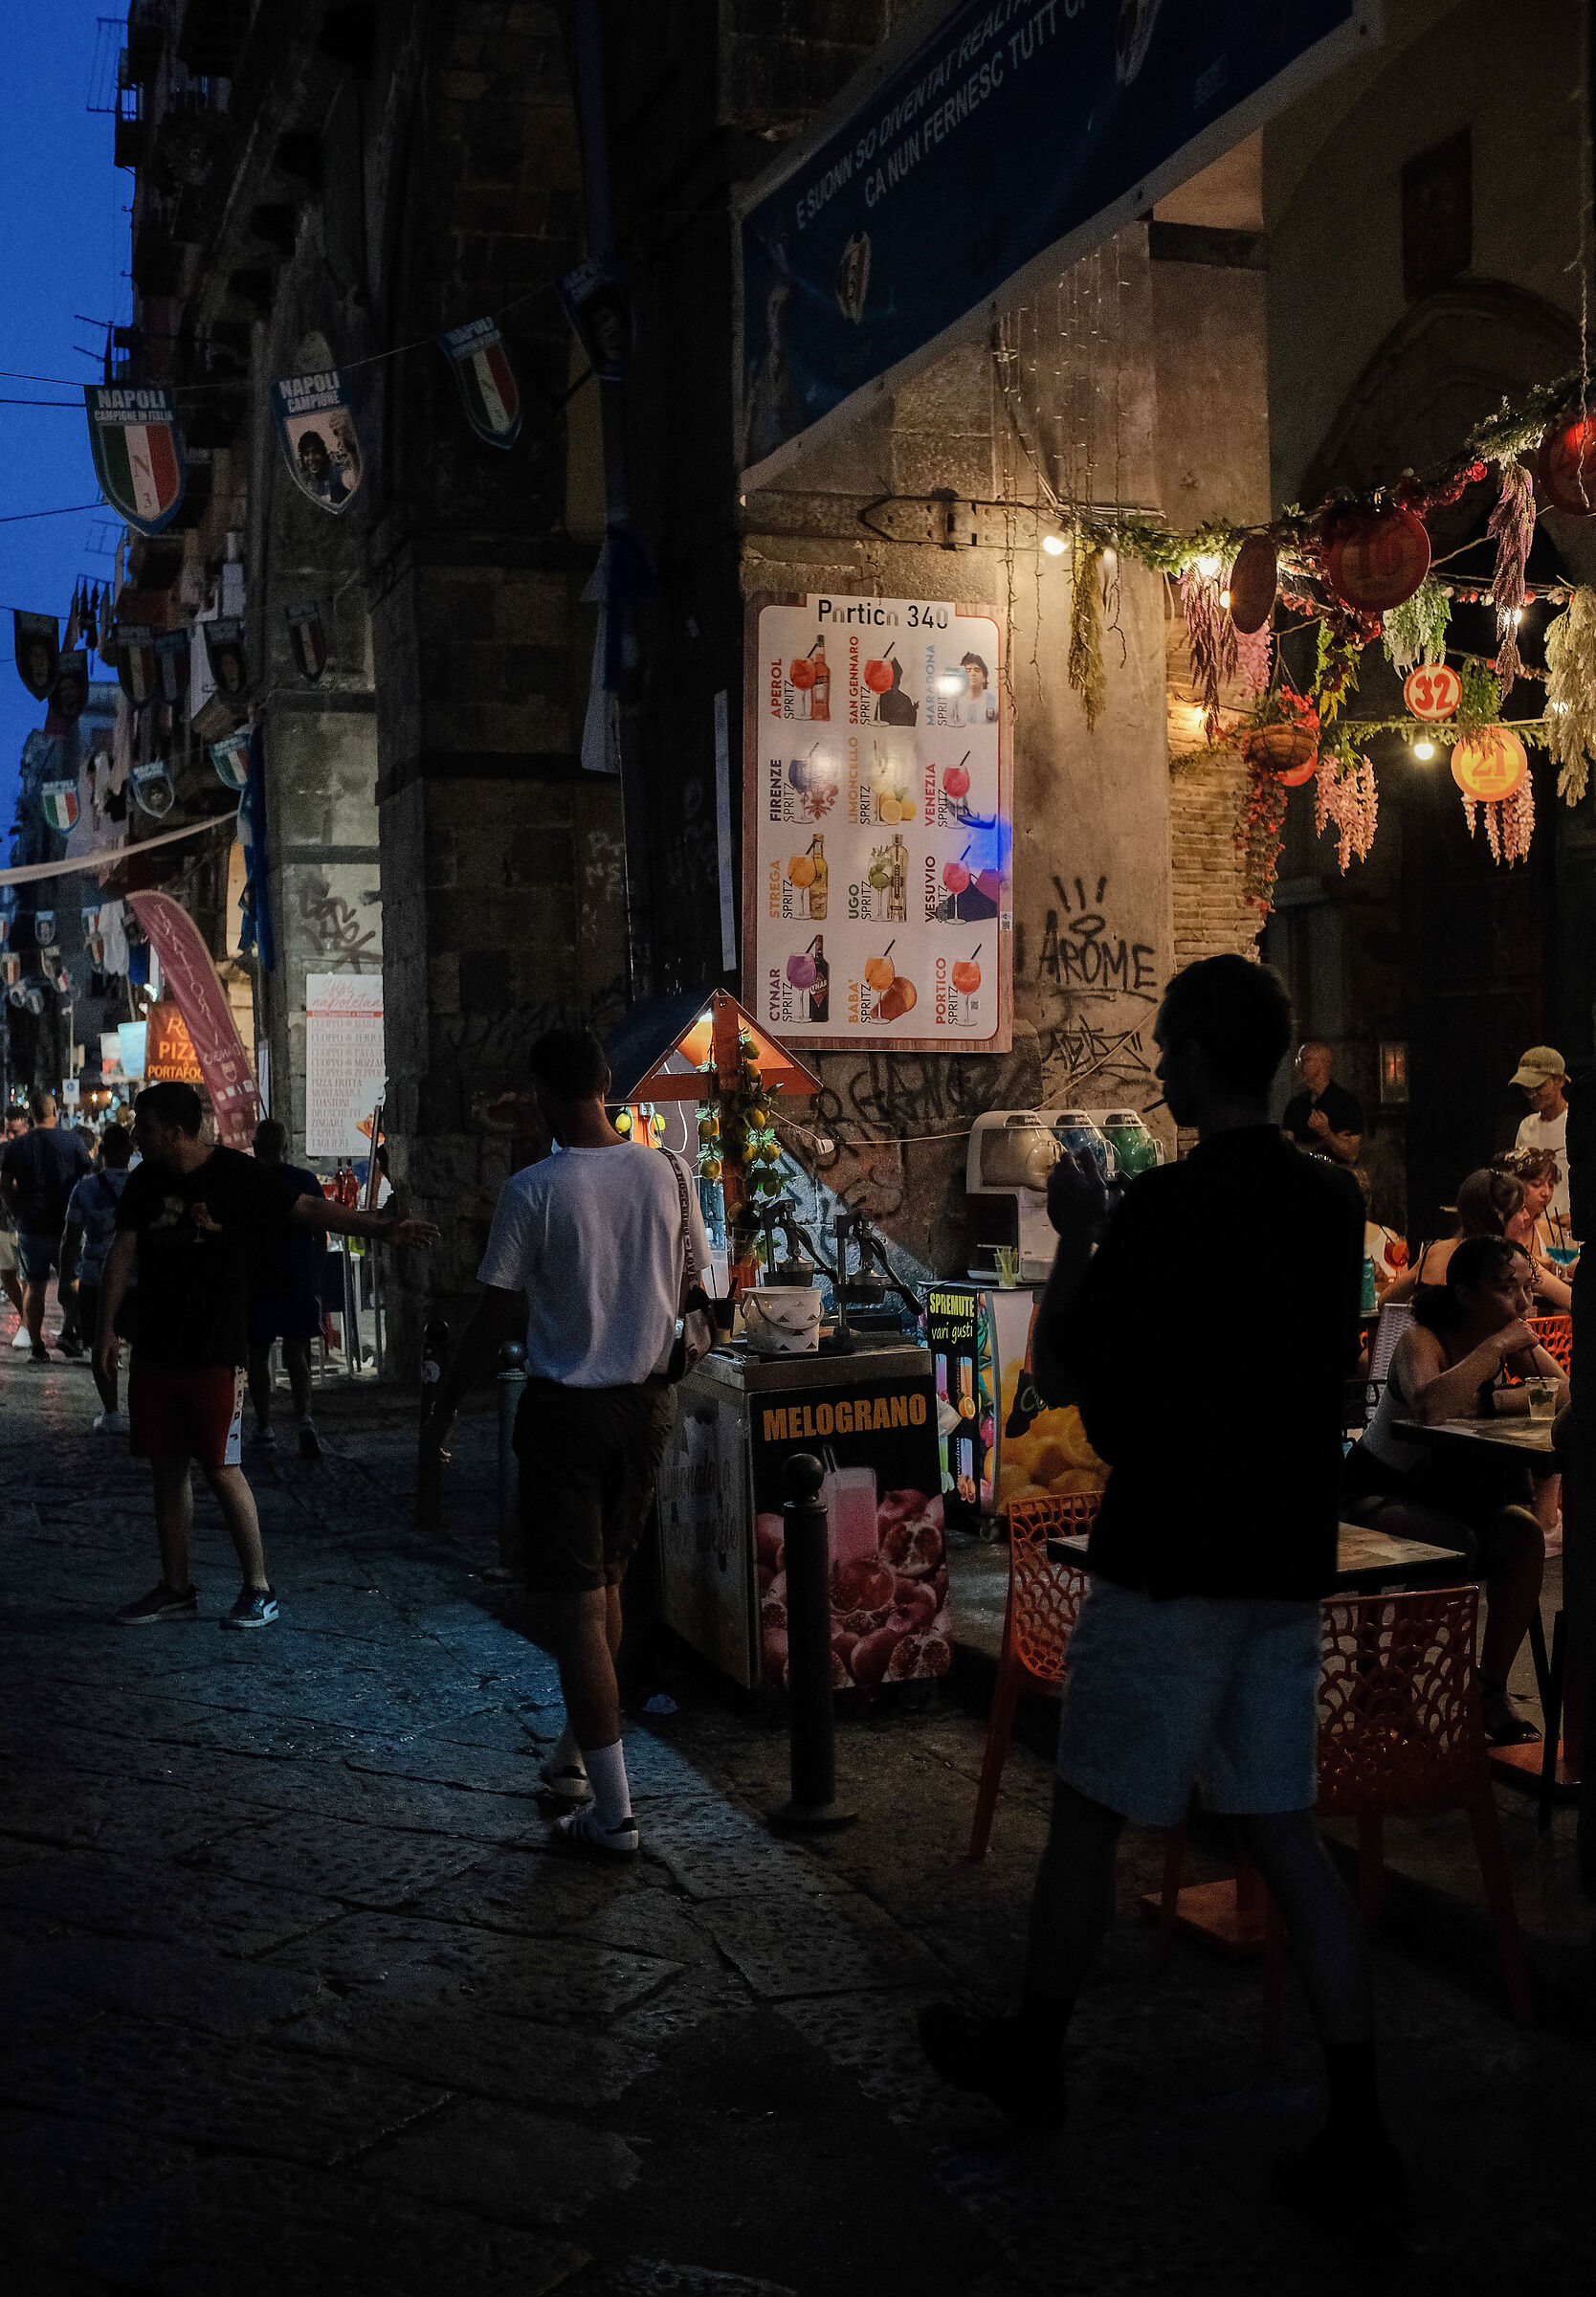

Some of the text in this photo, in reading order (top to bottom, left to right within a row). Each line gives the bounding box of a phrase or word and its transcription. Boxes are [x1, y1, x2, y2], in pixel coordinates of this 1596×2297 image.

[864, 0, 1056, 207] CA NUN FERNESC TUTT
[97, 390, 166, 409] NAPOLI
[279, 370, 340, 399] NAPOLI
[94, 410, 137, 422] CAMPIONE
[770, 658, 782, 718] APEROL
[784, 680, 794, 720] SPRITZ
[849, 636, 858, 725] SAN GENNARO
[1415, 673, 1454, 710] 32
[861, 685, 871, 725] SPRITZ
[769, 759, 782, 822] FIRENZE
[849, 736, 858, 824] LIMONCELLO
[924, 763, 936, 826] VENEZIA
[784, 782, 794, 822] SPRITZ
[860, 785, 871, 824] SPRITZ
[938, 788, 948, 828] SPRITZ
[769, 860, 781, 919] STREGA
[783, 880, 793, 919] SPRITZ
[849, 883, 859, 919] UGO
[861, 881, 872, 920] SPRITZ
[924, 856, 936, 923] VESUVIO
[769, 969, 781, 1021] CYNAR
[783, 982, 793, 1022] SPRITZ
[849, 979, 859, 1022] BABA'
[861, 984, 872, 1023] SPRITZ
[936, 957, 946, 1024] PORTICO
[948, 986, 959, 1025] SPRITZ
[159, 1040, 197, 1060] PIZZ
[929, 1292, 975, 1318] SPREMUTE
[931, 1319, 973, 1345] vari gusti
[763, 1394, 927, 1441] MELOGRANO
